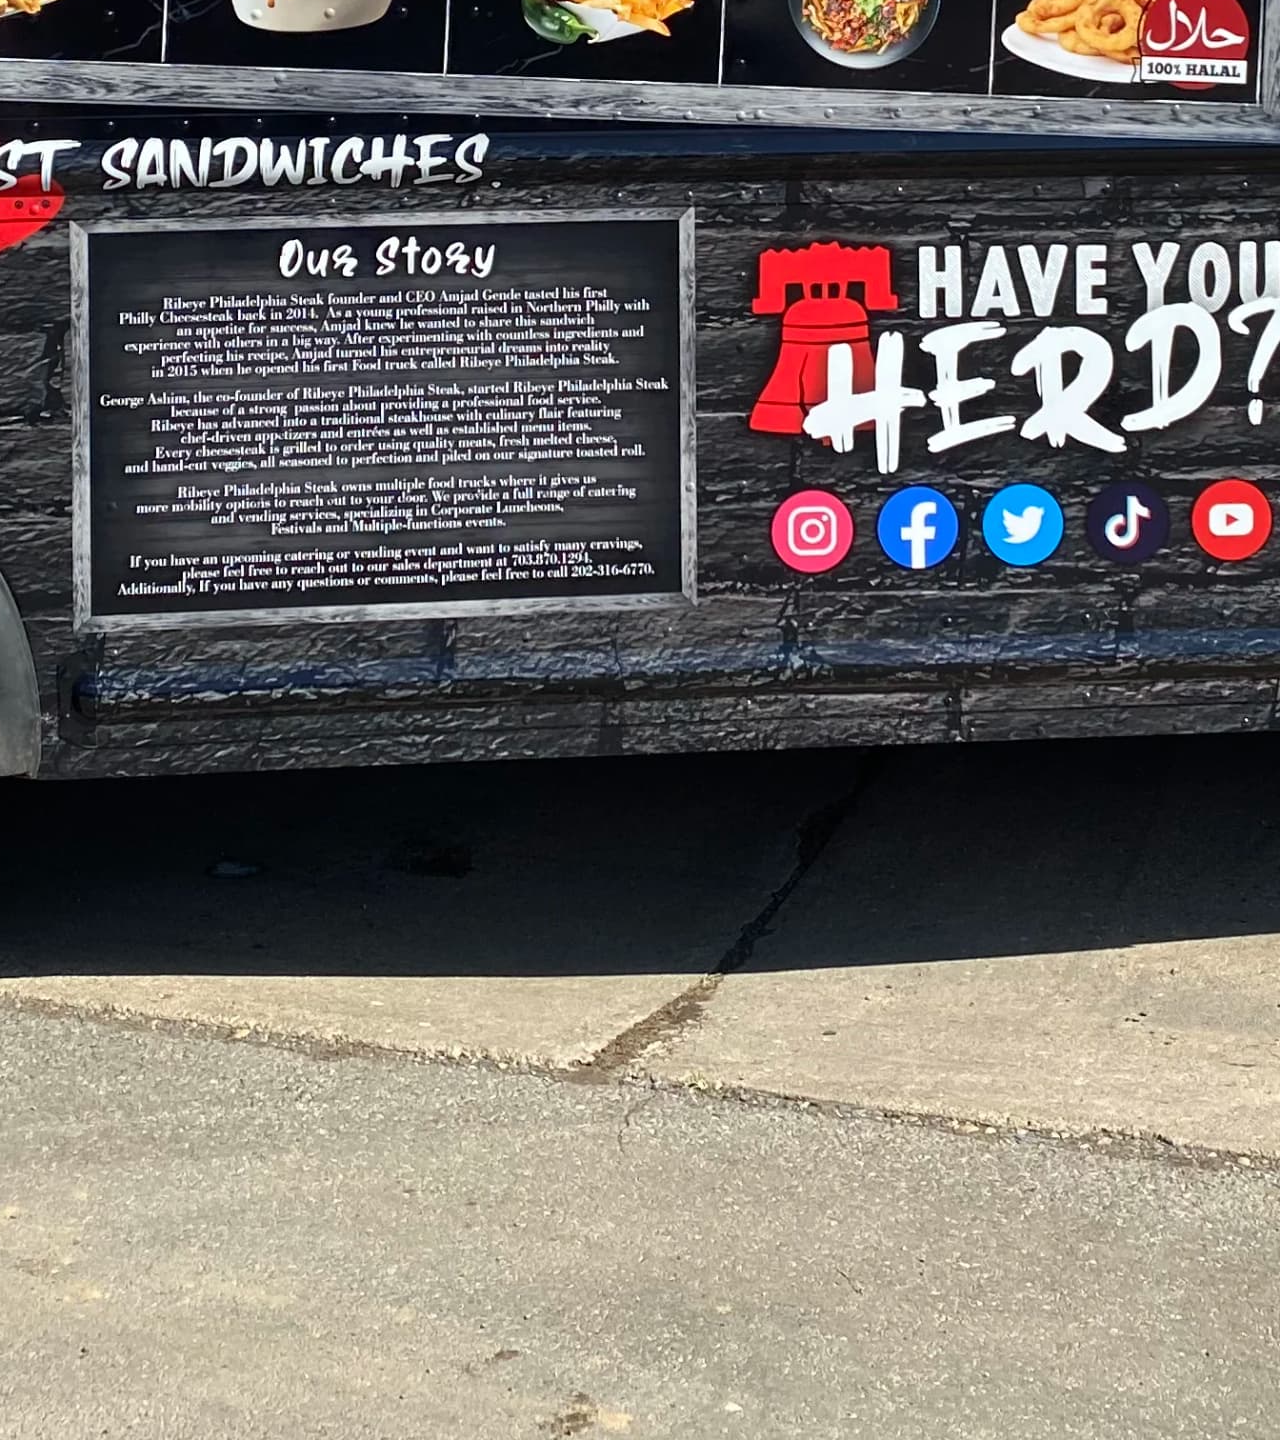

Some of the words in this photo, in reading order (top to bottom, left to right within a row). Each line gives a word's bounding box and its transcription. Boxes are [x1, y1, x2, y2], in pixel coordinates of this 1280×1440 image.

[1185, 61, 1241, 80] HALAL
[279, 238, 358, 278] Our
[376, 235, 495, 278] Story
[918, 244, 1108, 319] HAVE
[163, 297, 206, 312] Ribeye
[209, 295, 287, 309] Philadelphia
[290, 294, 324, 306] Steak
[328, 292, 376, 305] founder
[379, 291, 402, 303] and
[405, 290, 435, 302] CEO
[439, 289, 478, 304] Amjad
[524, 288, 559, 300] tasted
[563, 287, 580, 299] his
[583, 286, 608, 298] first
